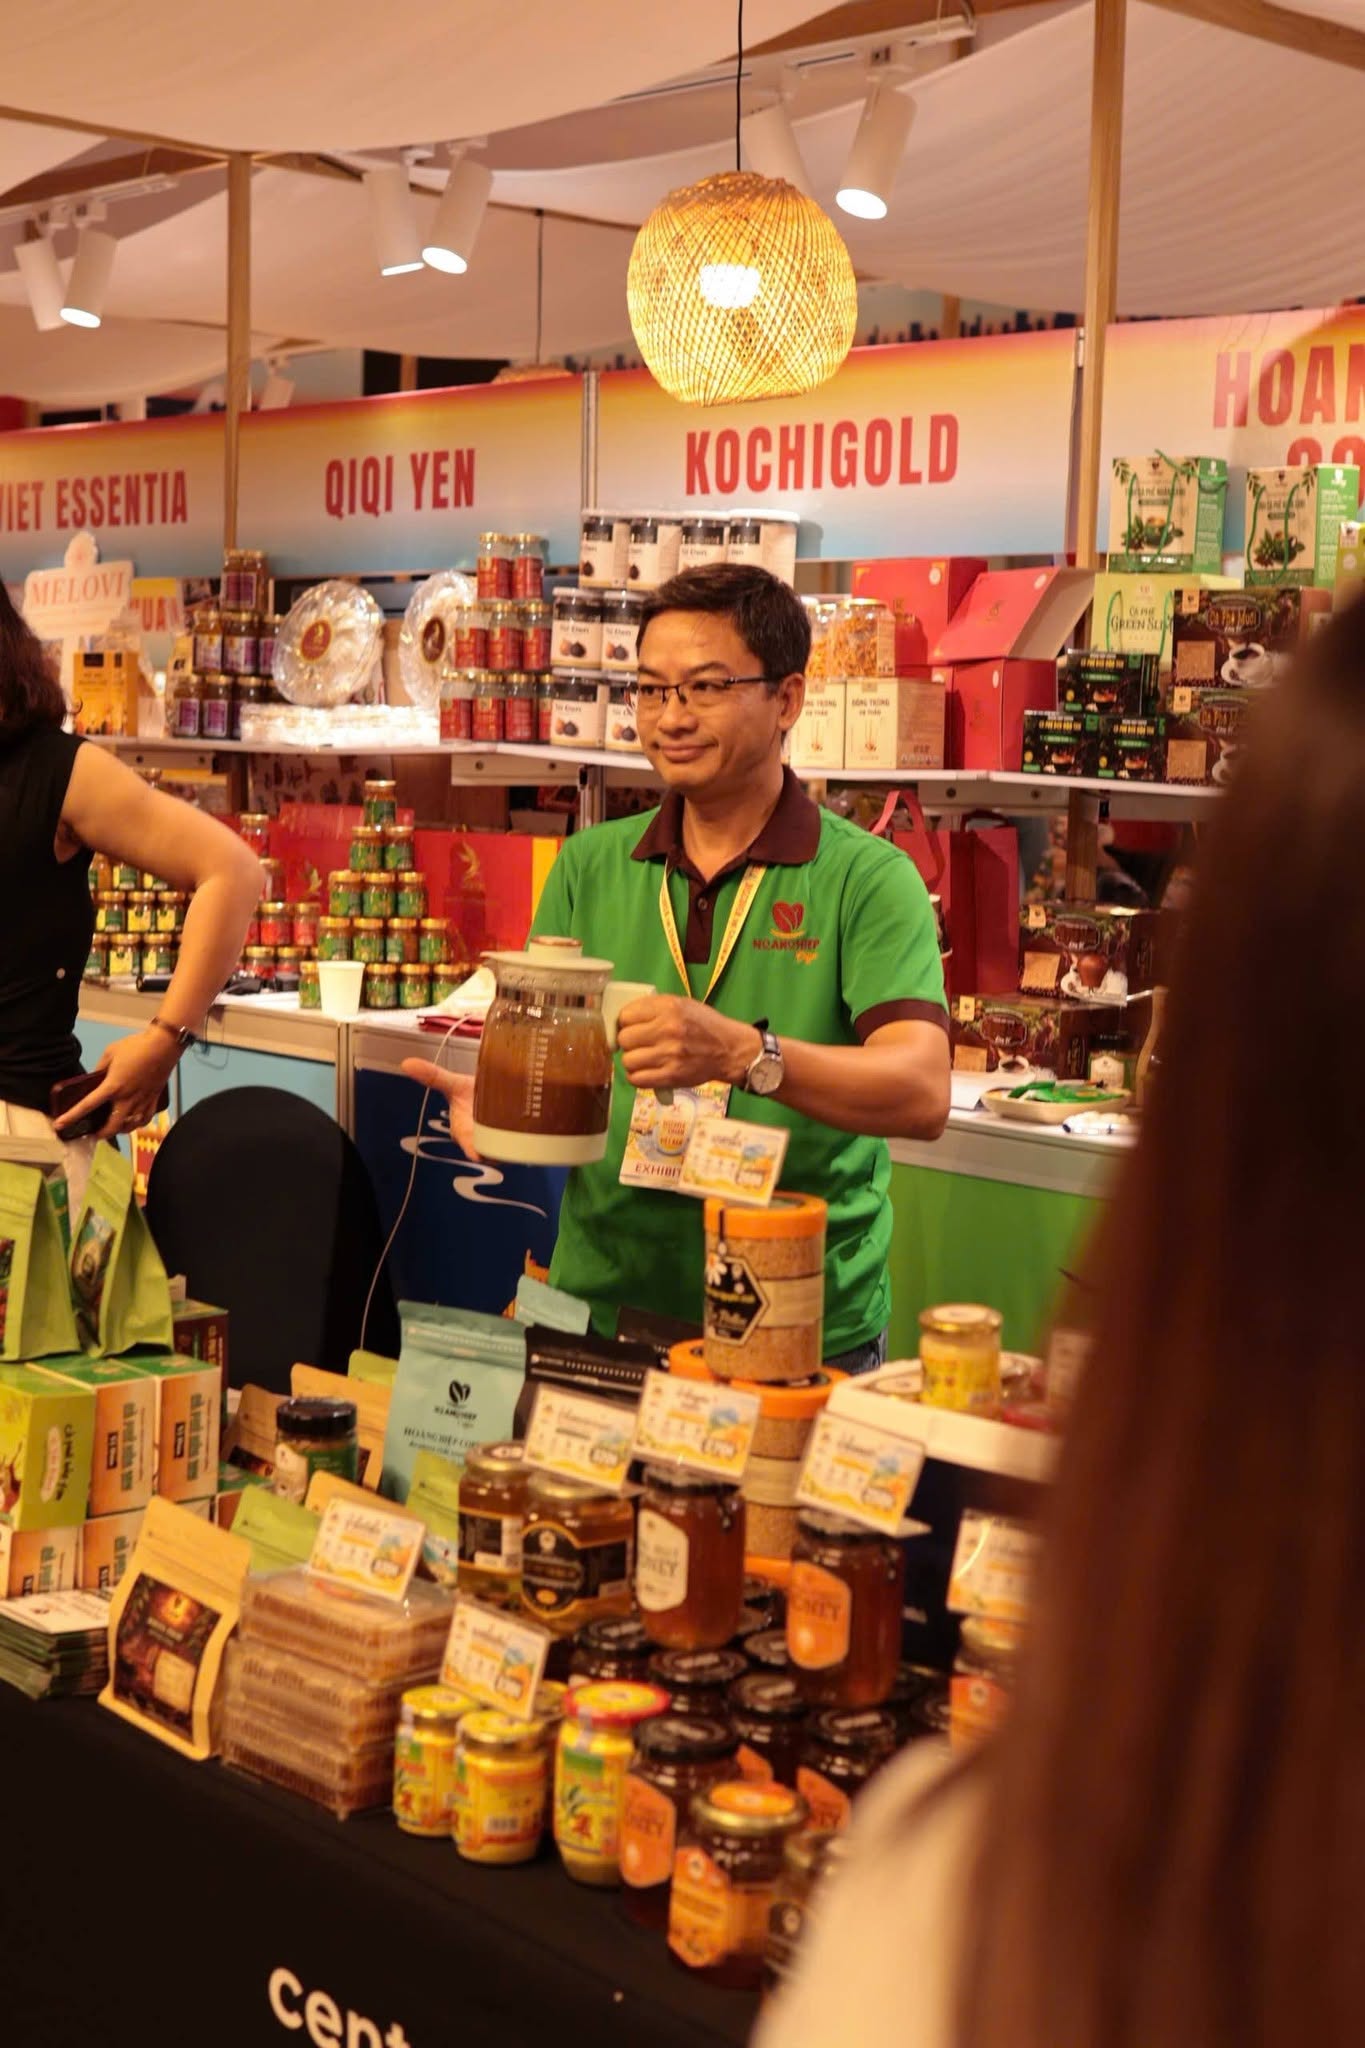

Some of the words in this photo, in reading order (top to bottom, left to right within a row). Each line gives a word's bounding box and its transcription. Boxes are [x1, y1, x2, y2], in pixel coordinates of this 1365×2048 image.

[325, 455, 394, 518] QIQI
[411, 447, 476, 510] YEN
[685, 413, 959, 495] KOCHIGOLD
[56, 469, 188, 530] ESSENTIA
[31, 571, 125, 605] MELOVI
